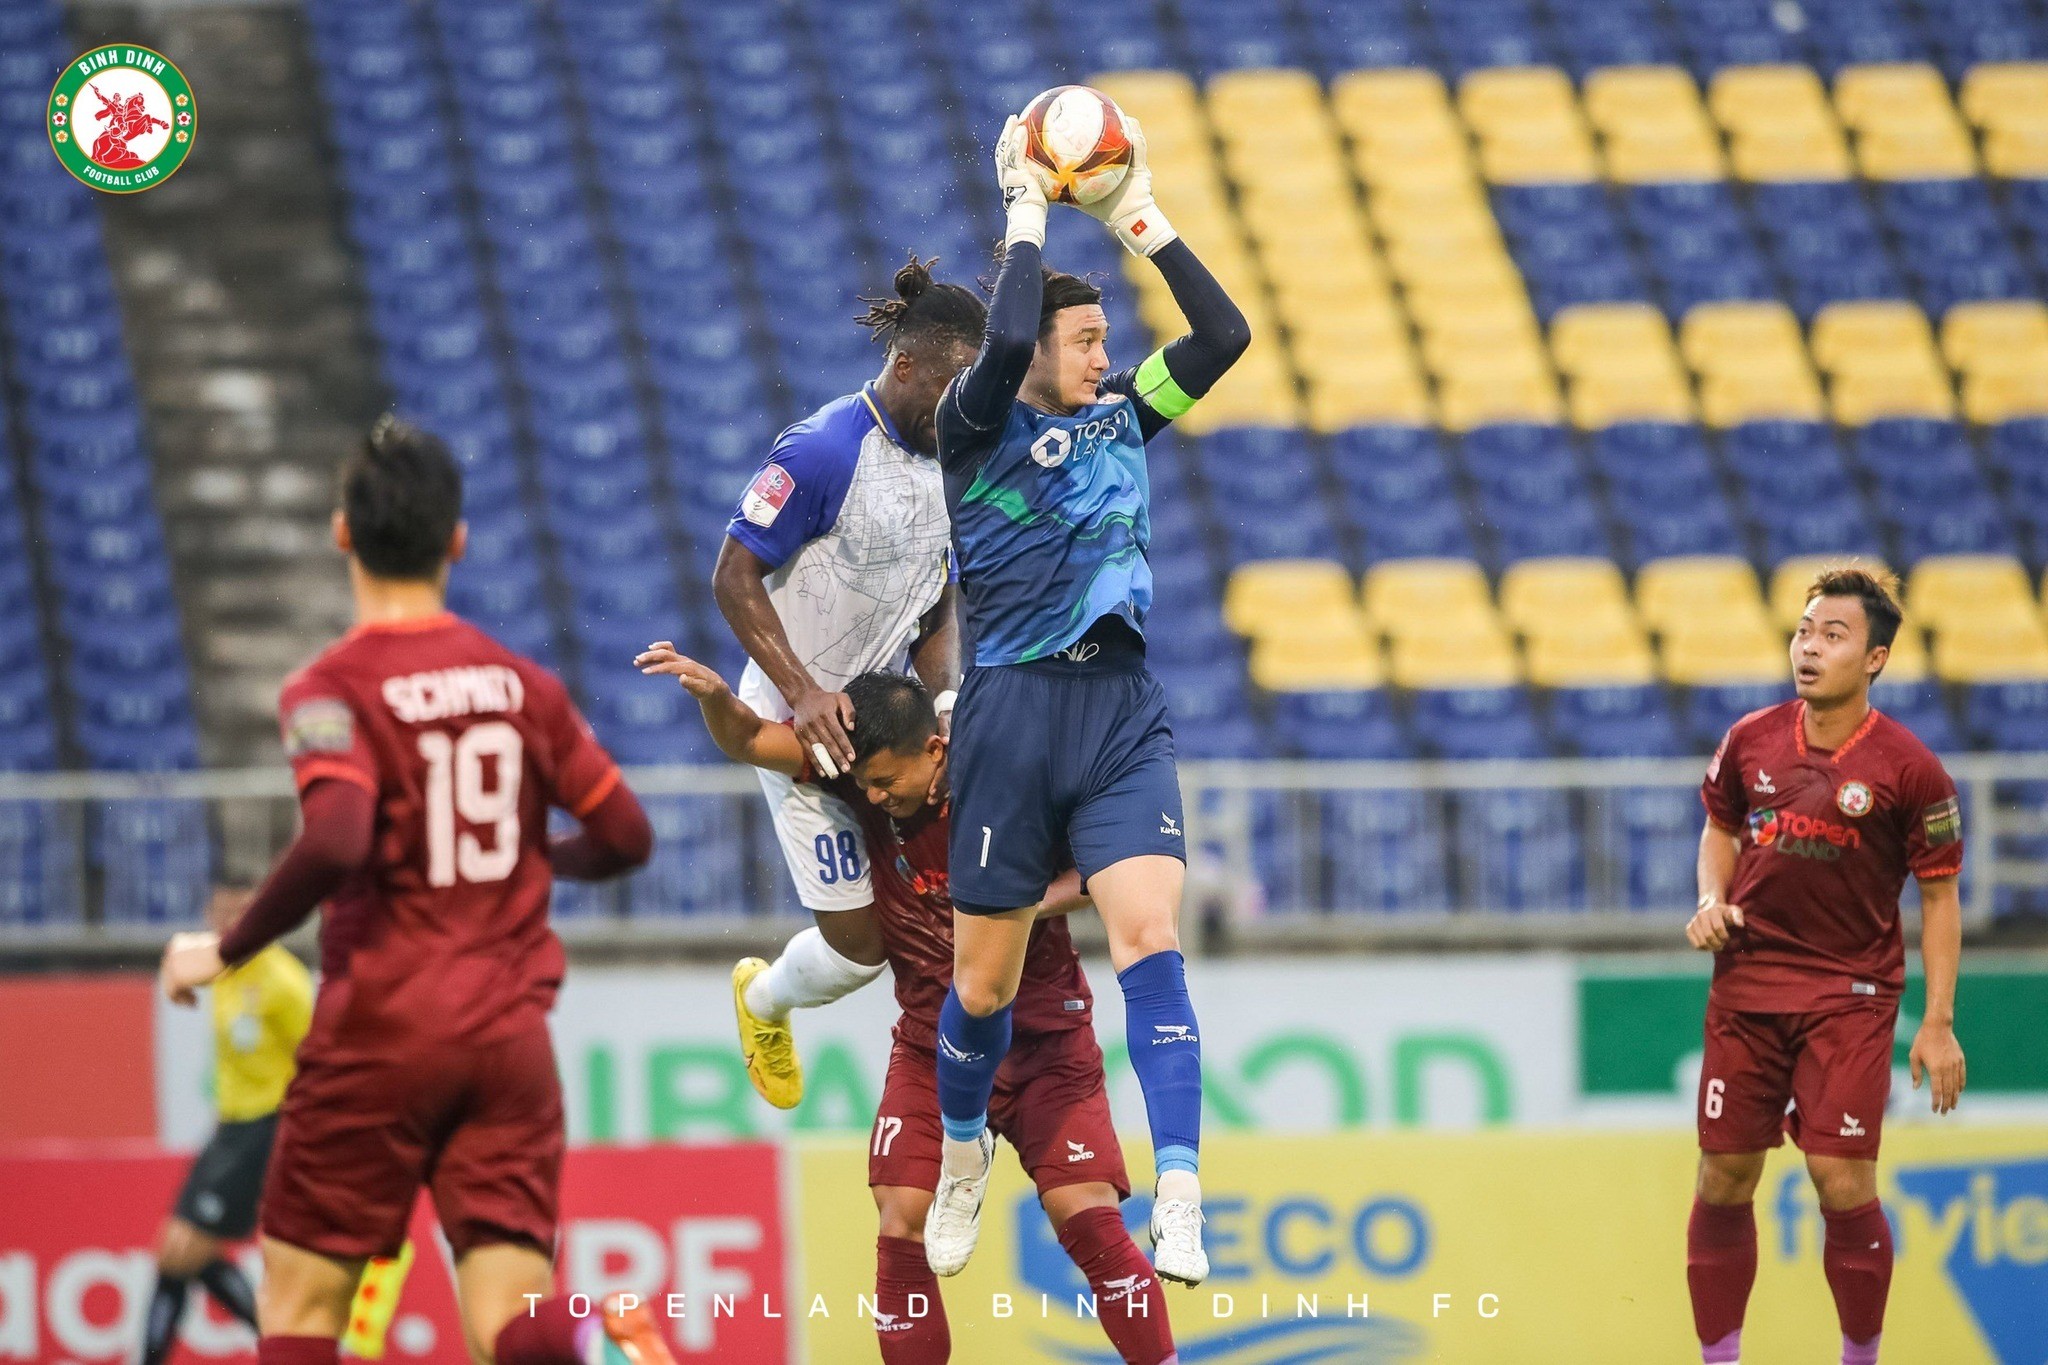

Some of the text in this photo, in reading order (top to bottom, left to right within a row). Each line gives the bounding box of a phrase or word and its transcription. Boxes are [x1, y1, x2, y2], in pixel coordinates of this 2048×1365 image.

[416, 721, 524, 888] 19
[814, 830, 862, 886] 98
[980, 826, 993, 868] 1
[1704, 1078, 1726, 1120] 6
[872, 1116, 903, 1157] 17
